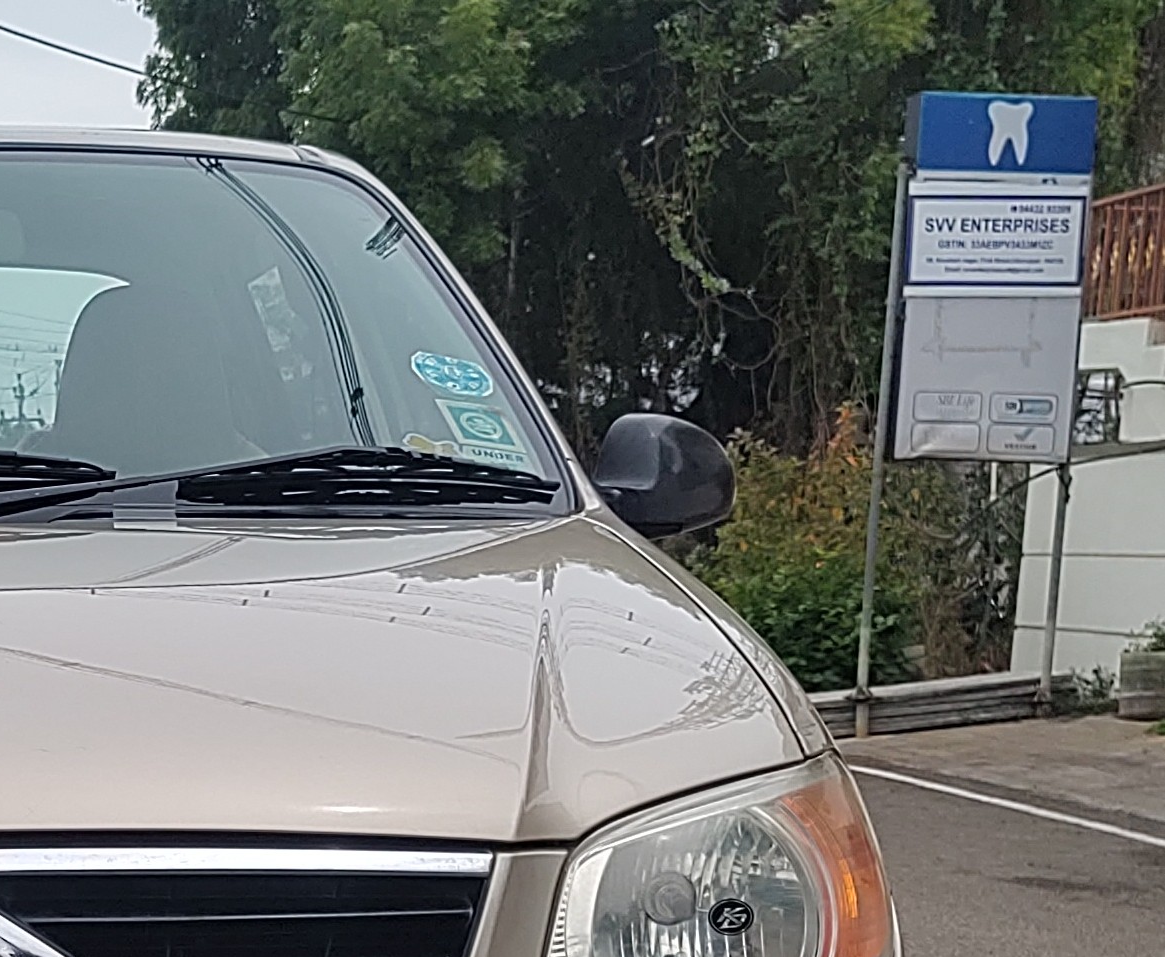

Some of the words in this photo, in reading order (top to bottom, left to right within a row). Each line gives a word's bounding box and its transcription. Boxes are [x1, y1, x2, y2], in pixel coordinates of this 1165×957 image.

[925, 217, 956, 233] SVV
[960, 218, 1070, 234] ENTERPRISES
[472, 448, 524, 463] UNDER
